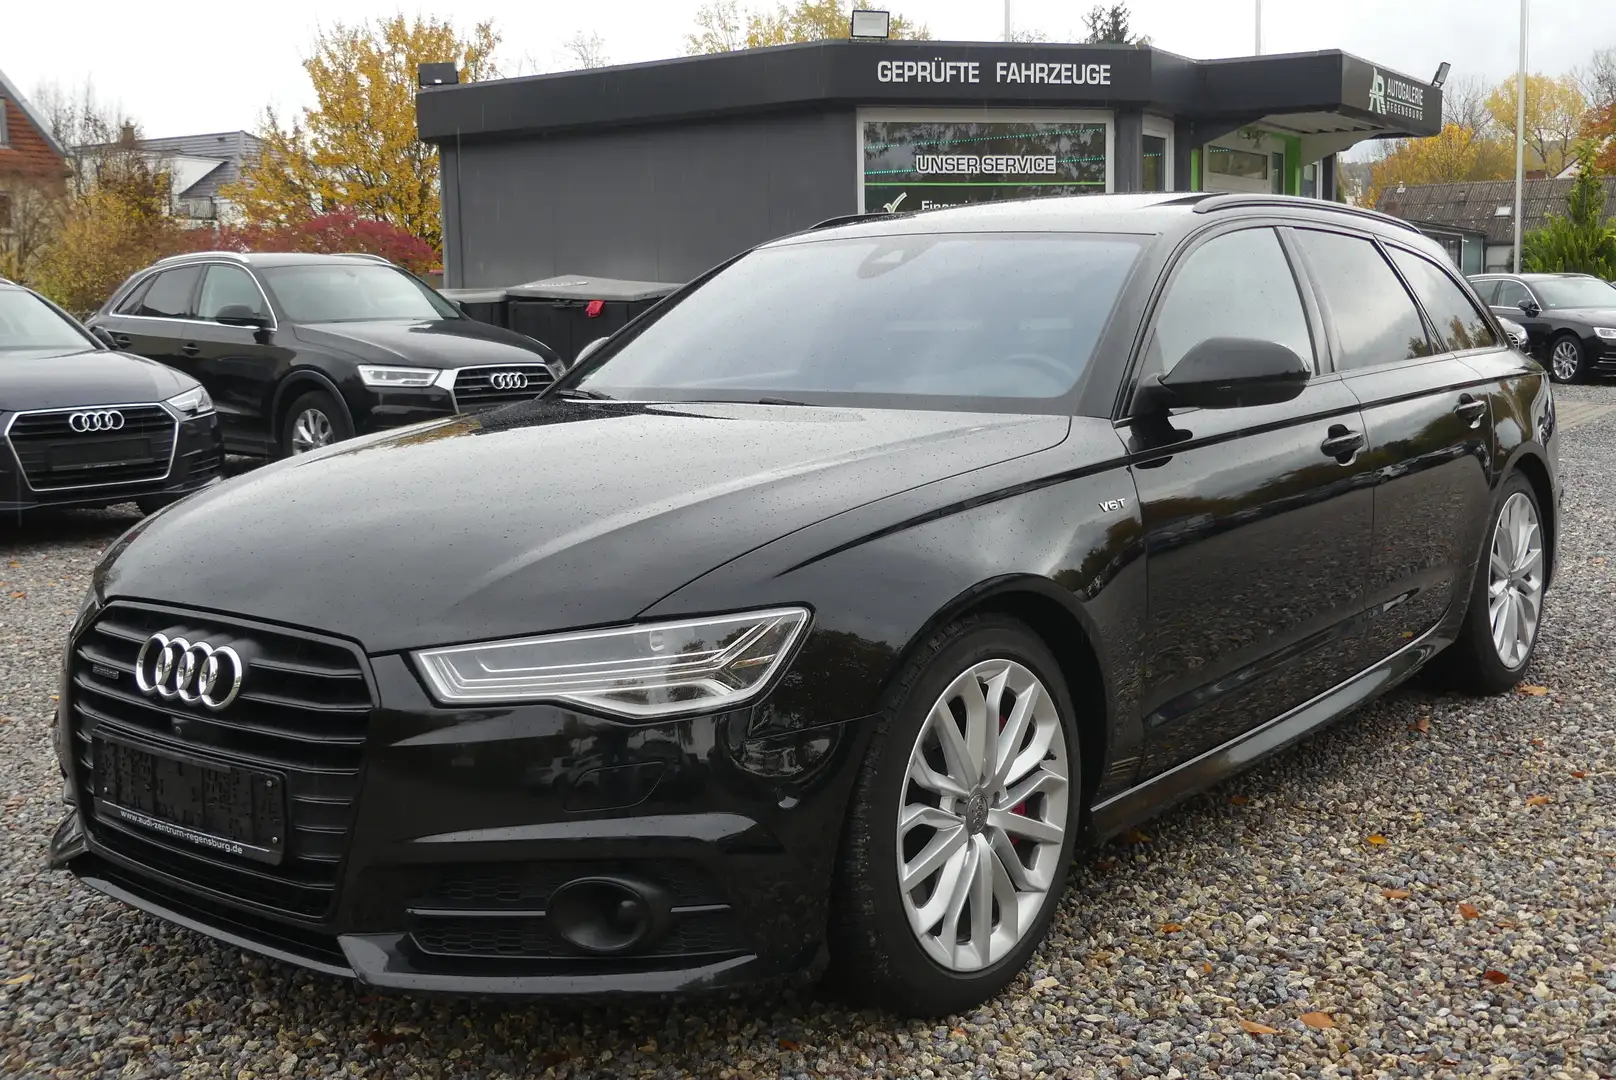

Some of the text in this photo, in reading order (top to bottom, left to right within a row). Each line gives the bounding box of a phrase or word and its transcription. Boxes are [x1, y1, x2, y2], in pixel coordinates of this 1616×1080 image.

[877, 57, 1111, 85] GEPRÜFTE FAHRZEUGE
[1386, 78, 1424, 106] AUTOGALERIE
[1386, 101, 1423, 120] REGENSBURG
[915, 155, 1056, 174] UNSER SERVICE
[1098, 498, 1125, 513] V6T
[120, 809, 243, 854] www.audi-zentrum-regensburg.de
